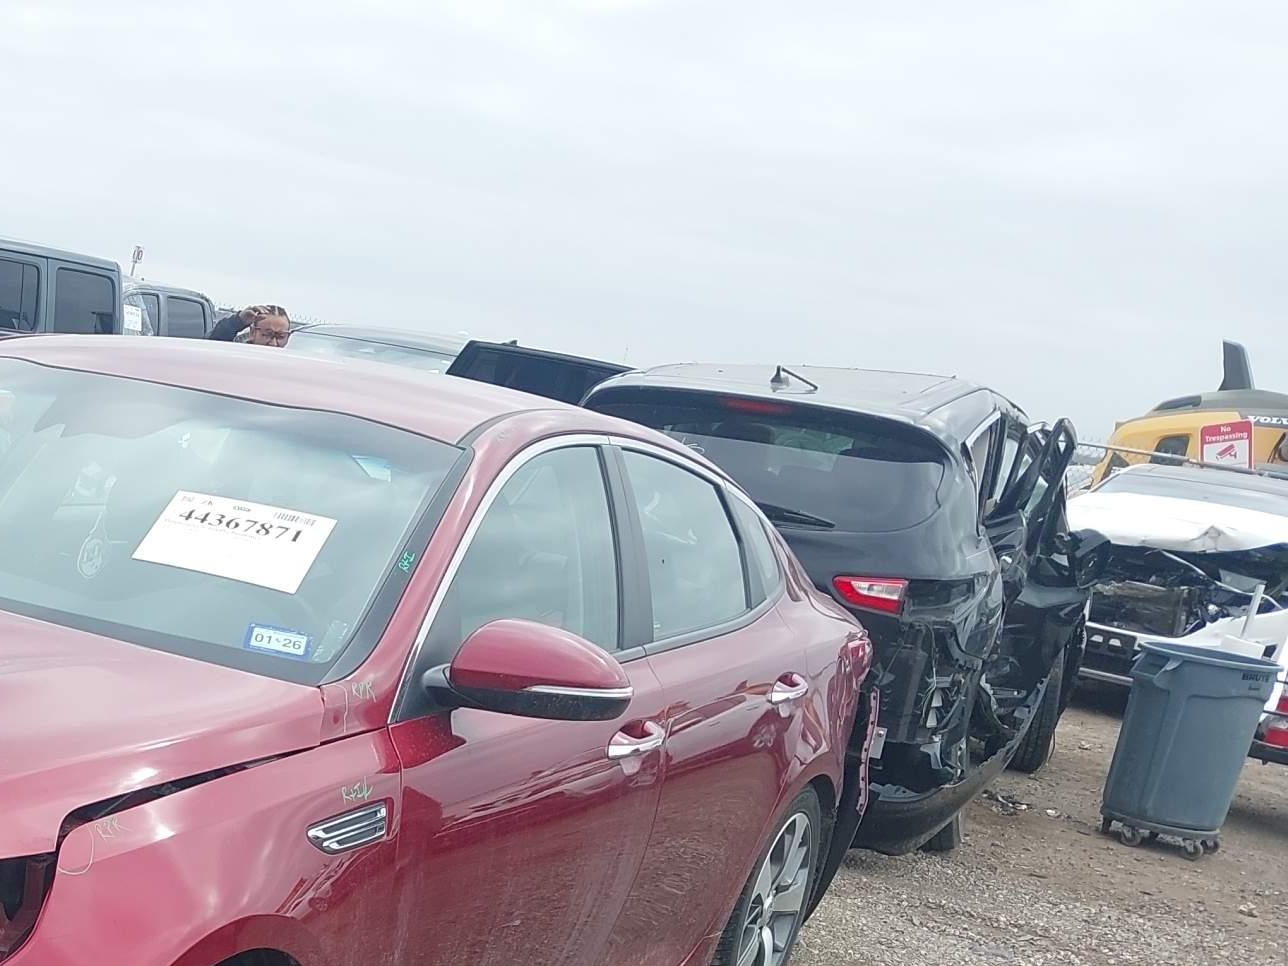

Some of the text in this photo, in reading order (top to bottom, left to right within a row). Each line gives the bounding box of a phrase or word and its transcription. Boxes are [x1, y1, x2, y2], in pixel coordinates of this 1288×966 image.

[1220, 425, 1232, 433] No
[1205, 432, 1248, 443] Trespassing
[179, 509, 303, 543] 44367871
